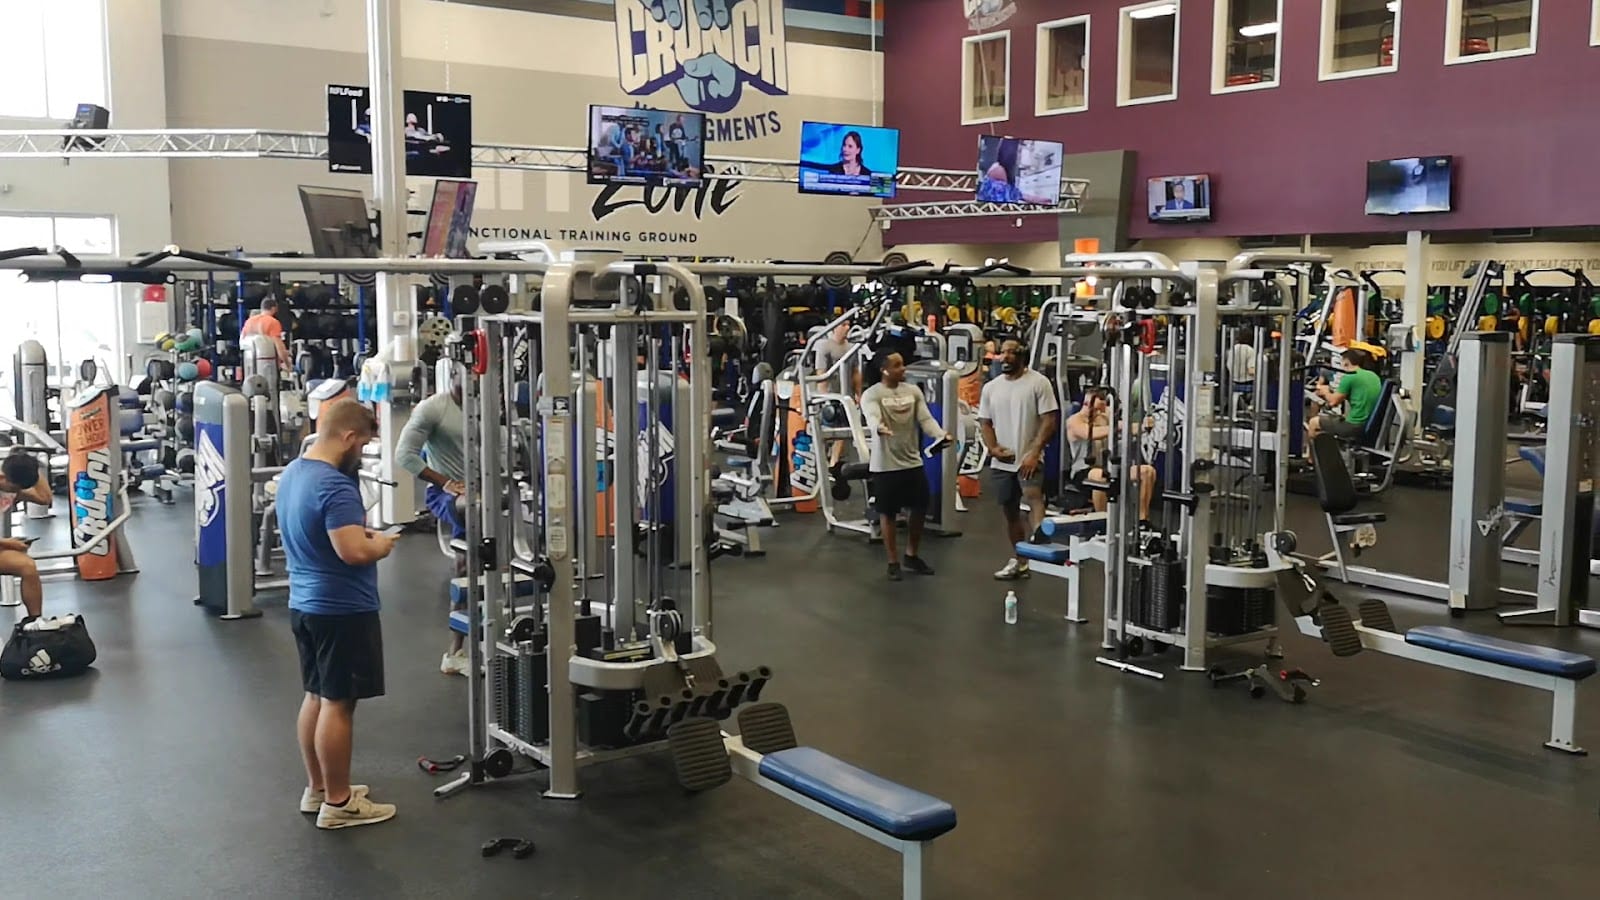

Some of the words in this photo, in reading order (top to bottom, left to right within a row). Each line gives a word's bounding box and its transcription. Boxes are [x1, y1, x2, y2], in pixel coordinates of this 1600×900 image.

[615, 0, 788, 95] CRUNCH
[704, 110, 782, 142] GMENTS
[469, 227, 552, 240] NCTIONAL
[559, 229, 632, 242] TRAINING
[638, 231, 698, 243] GROUND
